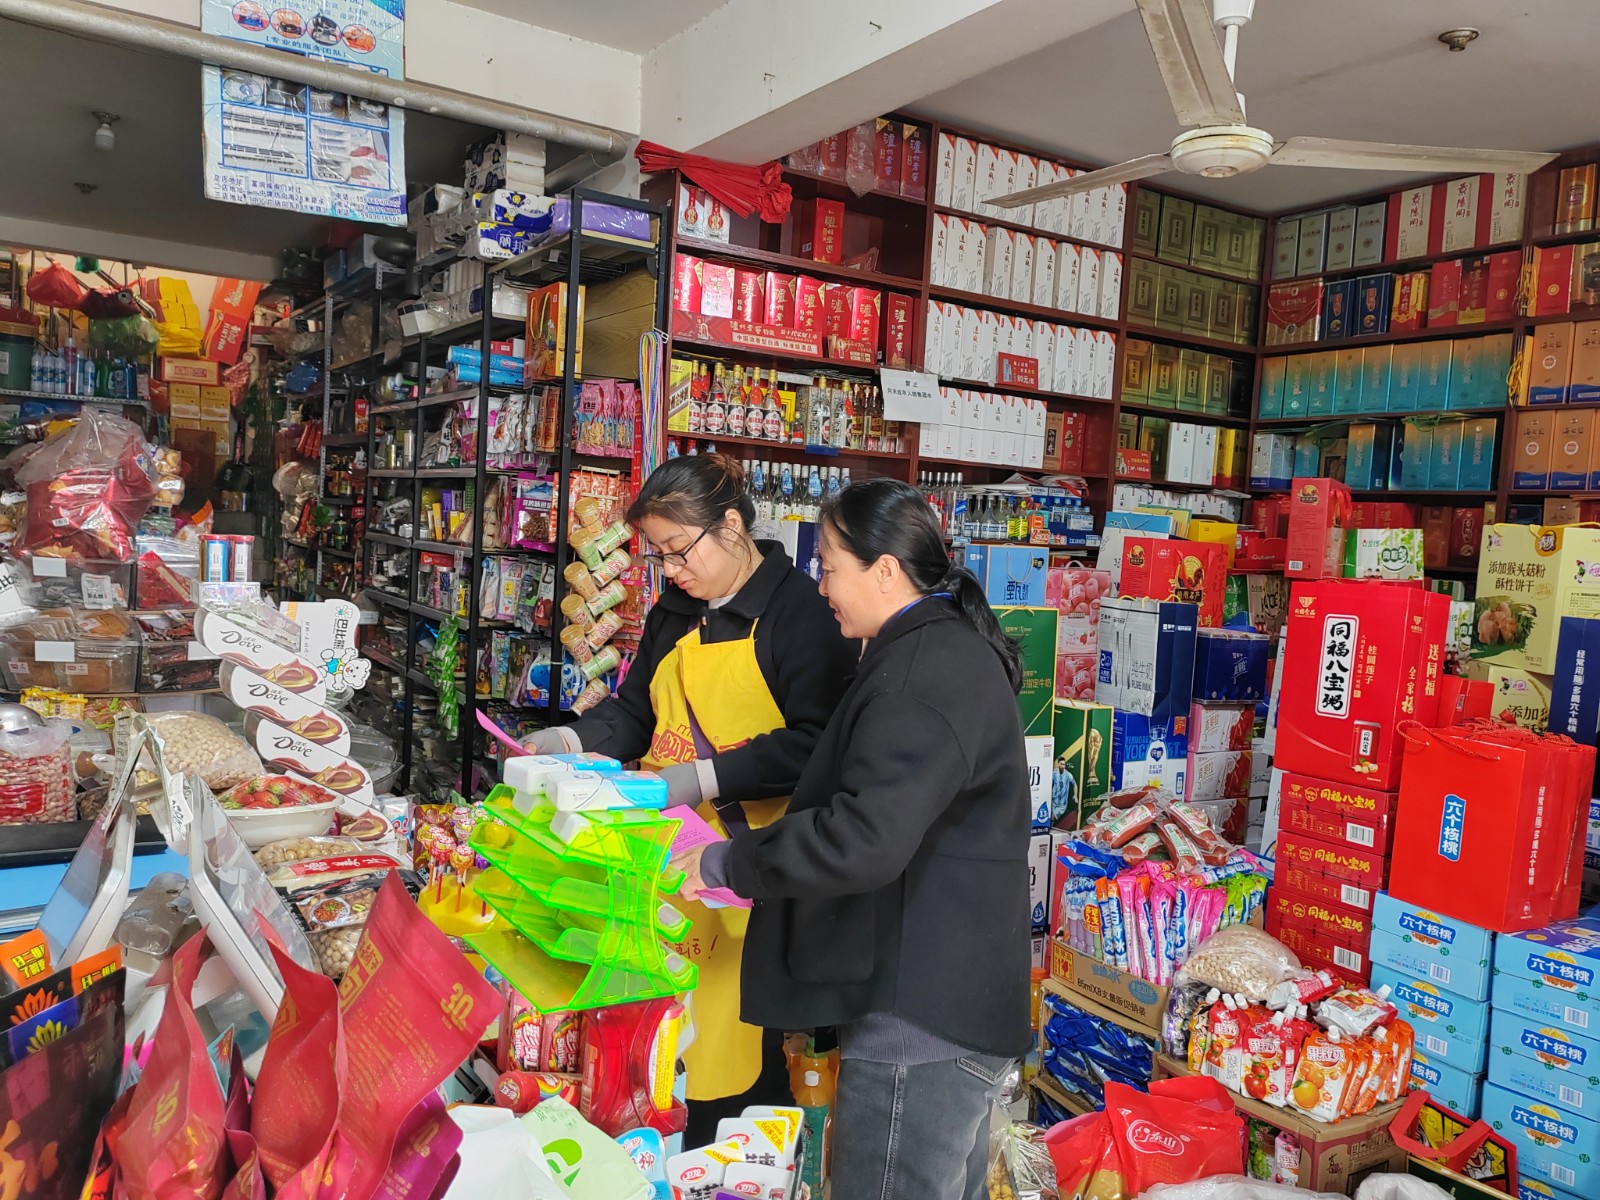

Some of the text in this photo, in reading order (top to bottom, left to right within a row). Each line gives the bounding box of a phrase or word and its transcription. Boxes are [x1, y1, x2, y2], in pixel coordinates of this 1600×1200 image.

[499, 233, 525, 255] 丽邦
[774, 288, 787, 327] 泸州老
[803, 294, 817, 332] 泸州老
[831, 299, 845, 339] 泸州老
[859, 303, 873, 342] 泸州老
[887, 386, 933, 399] 向未成年人销售酒水
[905, 379, 919, 388] 禁止
[1488, 560, 1546, 579] 添加猴头菇粉
[1495, 577, 1535, 593] 酥性饼干
[219, 629, 263, 654] Dove
[1321, 620, 1351, 713] 同福八宝粥
[1424, 643, 1439, 697] 送同福
[247, 682, 289, 706] Dove
[1401, 666, 1416, 714] 全家福
[272, 734, 313, 758] Dove
[1320, 788, 1376, 811] 同福八宝粥
[1441, 801, 1465, 855] 六个核桃
[1314, 849, 1371, 873] 同福八宝粥
[1308, 906, 1364, 933] 同福八宝粥
[1402, 915, 1453, 942] 六个核桃
[1531, 957, 1591, 984] 六个核桃
[1397, 984, 1451, 1015] 六个核桃
[514, 1029, 522, 1059] Skittles
[557, 1037, 566, 1069] Skittles
[1247, 1037, 1281, 1054] 果粒爽
[1306, 1045, 1345, 1063] 果粒爽
[1524, 1030, 1584, 1062] 六个核桃
[1412, 1063, 1439, 1085] 核桃
[1514, 1108, 1575, 1141] 六个核桃
